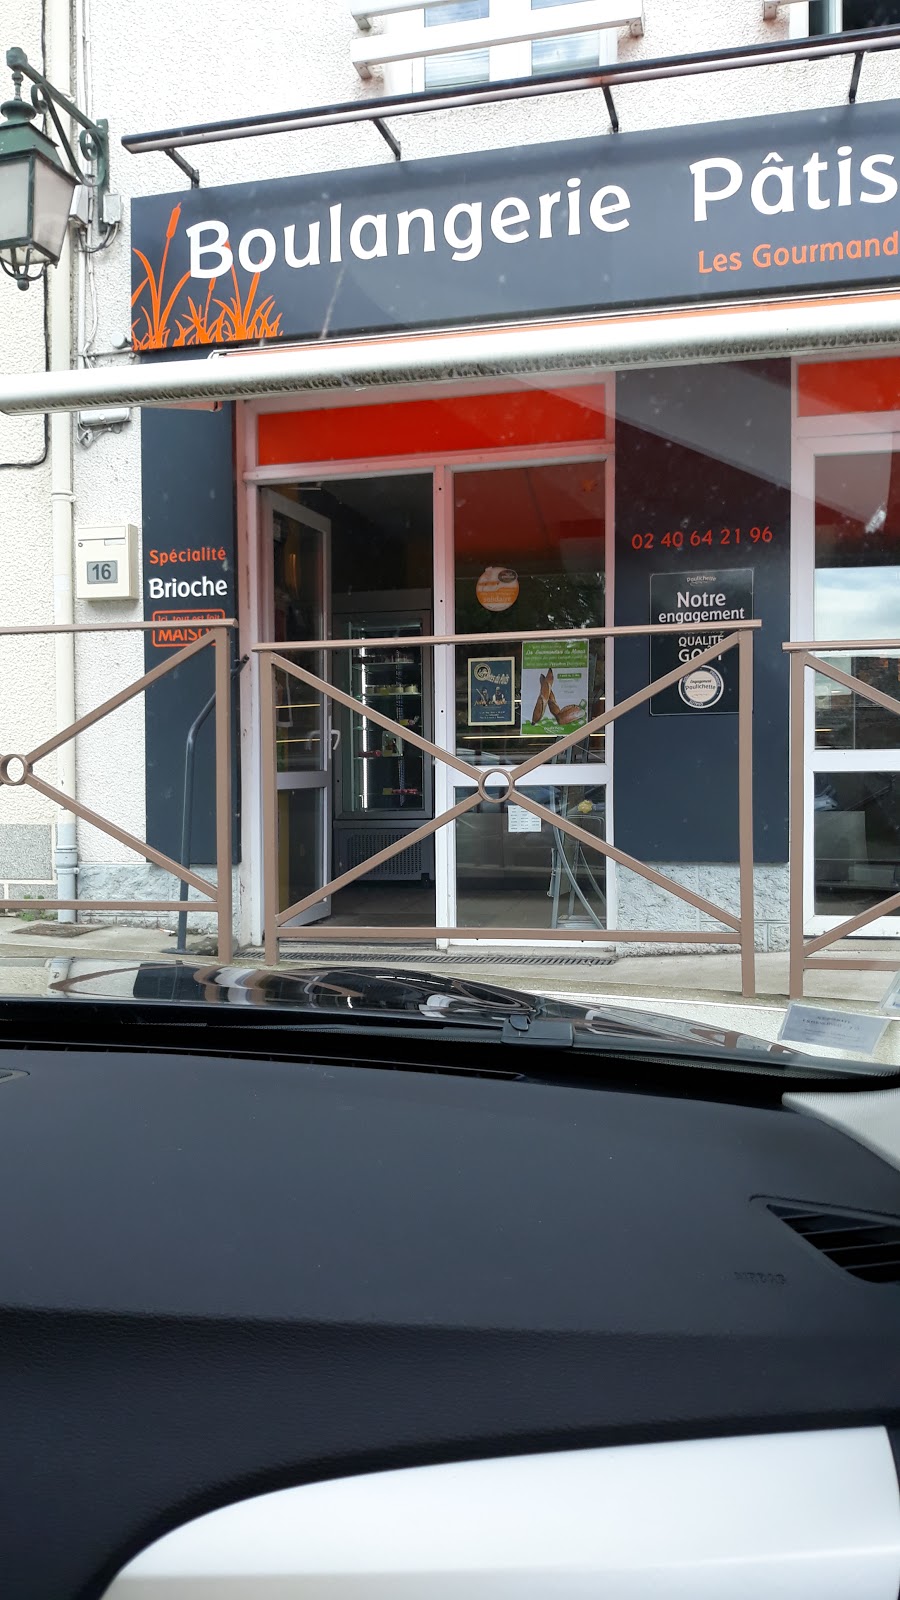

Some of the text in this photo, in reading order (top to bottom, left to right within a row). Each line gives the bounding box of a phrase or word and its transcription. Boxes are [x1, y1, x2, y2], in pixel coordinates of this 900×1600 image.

[185, 145, 899, 279] Boulangerie Pâtis
[698, 230, 899, 274] Les Gourmand
[631, 526, 773, 549] 02 40 64 21 96
[149, 546, 227, 567] Spécialité
[91, 563, 112, 581] 16
[148, 576, 228, 599] Brioche
[676, 591, 727, 608] Notre
[658, 608, 745, 625] engagement
